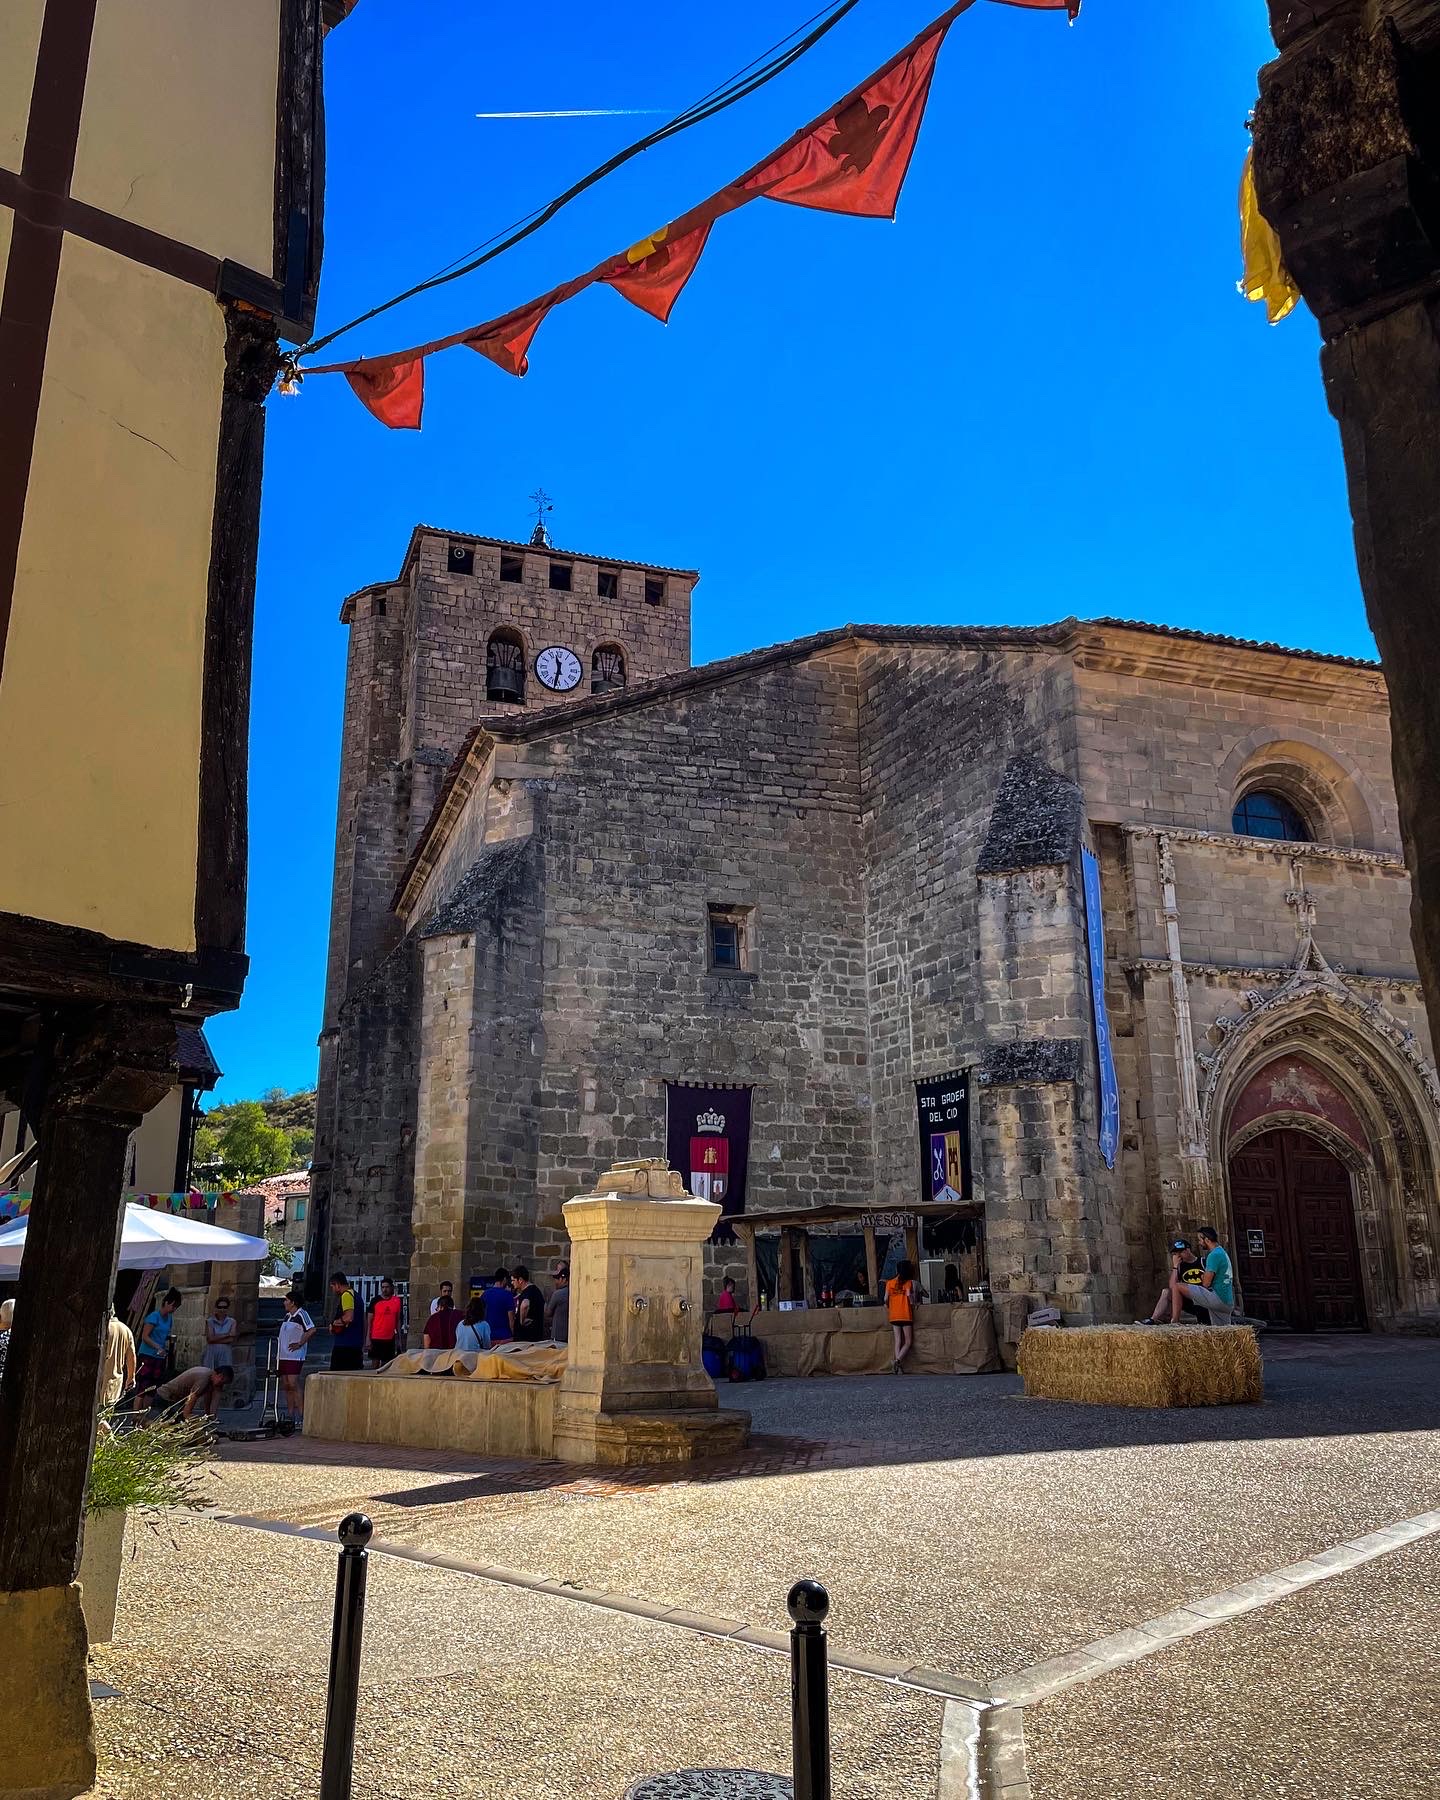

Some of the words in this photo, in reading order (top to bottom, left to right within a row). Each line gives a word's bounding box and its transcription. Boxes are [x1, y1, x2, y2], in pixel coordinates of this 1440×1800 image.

[921, 1097, 936, 1108] STA
[941, 1088, 965, 1105] GADEA
[929, 1111, 944, 1123] DEL
[946, 1107, 958, 1120] CID
